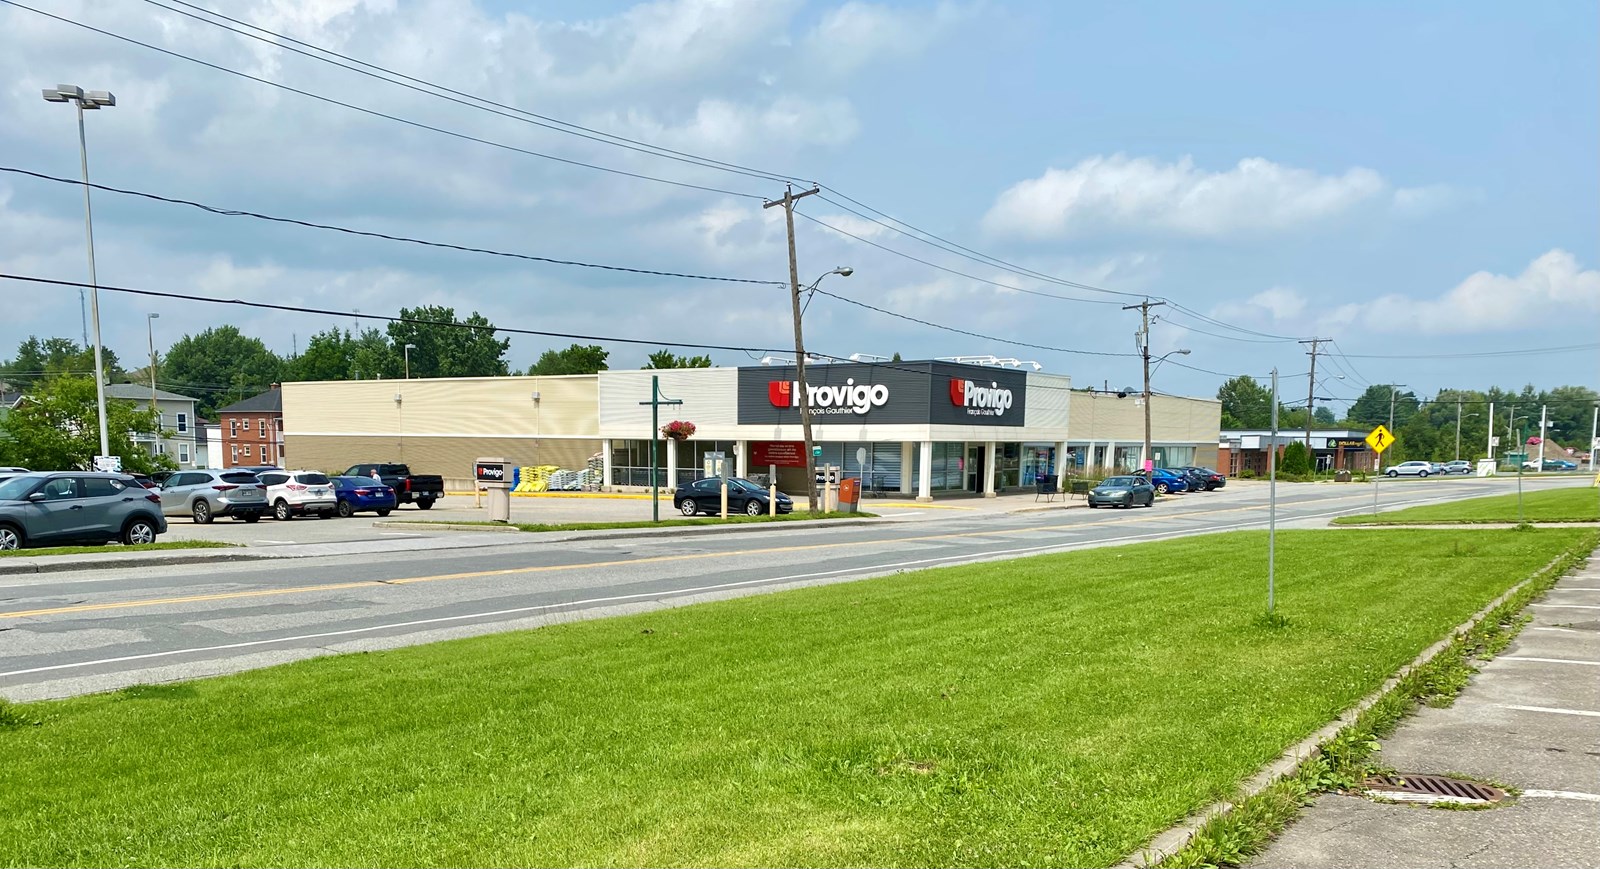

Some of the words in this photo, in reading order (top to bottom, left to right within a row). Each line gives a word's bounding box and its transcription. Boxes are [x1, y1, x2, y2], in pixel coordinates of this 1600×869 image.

[793, 378, 888, 414] Provigo
[964, 381, 1013, 416] Provigo
[826, 407, 853, 415] Gauthier
[483, 467, 503, 478] Provigo
